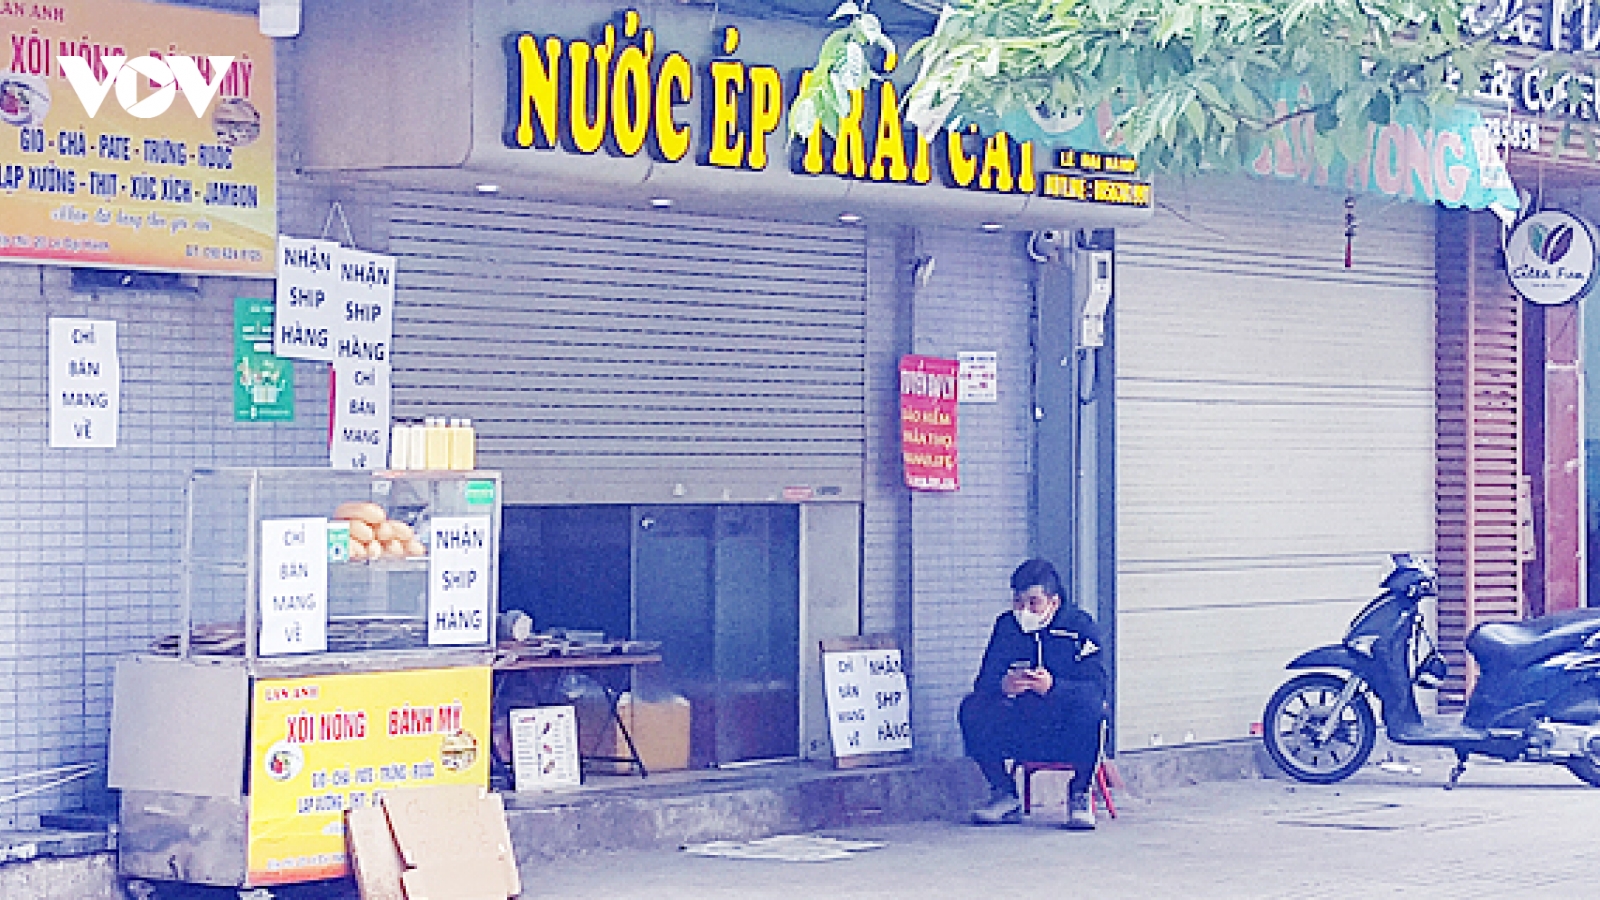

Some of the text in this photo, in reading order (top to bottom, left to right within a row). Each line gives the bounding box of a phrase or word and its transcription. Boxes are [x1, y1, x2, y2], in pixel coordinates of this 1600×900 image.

[11, 27, 50, 77] XÔI
[512, 9, 692, 162] NƯỚC
[706, 26, 783, 171] ÉP
[99, 133, 131, 161] PATE
[203, 182, 258, 208] JAMBON
[284, 246, 331, 273] NHẬN
[341, 262, 390, 290] NHẬN
[290, 287, 325, 309] SHIP
[346, 301, 382, 322] SHIP
[281, 321, 329, 349] HÀNG
[338, 335, 385, 361] HÀNG
[62, 391, 109, 408] MANG
[343, 427, 382, 445] MANG
[436, 523, 484, 555] NHẬN
[441, 570, 477, 591] SHIP
[273, 593, 317, 611] MANG
[433, 604, 483, 631] HÀNG
[265, 686, 319, 701] LAN ANH
[875, 691, 901, 709] SHIP
[287, 709, 314, 743] XÔI
[320, 707, 365, 740] NÓNG
[388, 702, 435, 735] BÁNH
[877, 720, 910, 741] HÀNG
